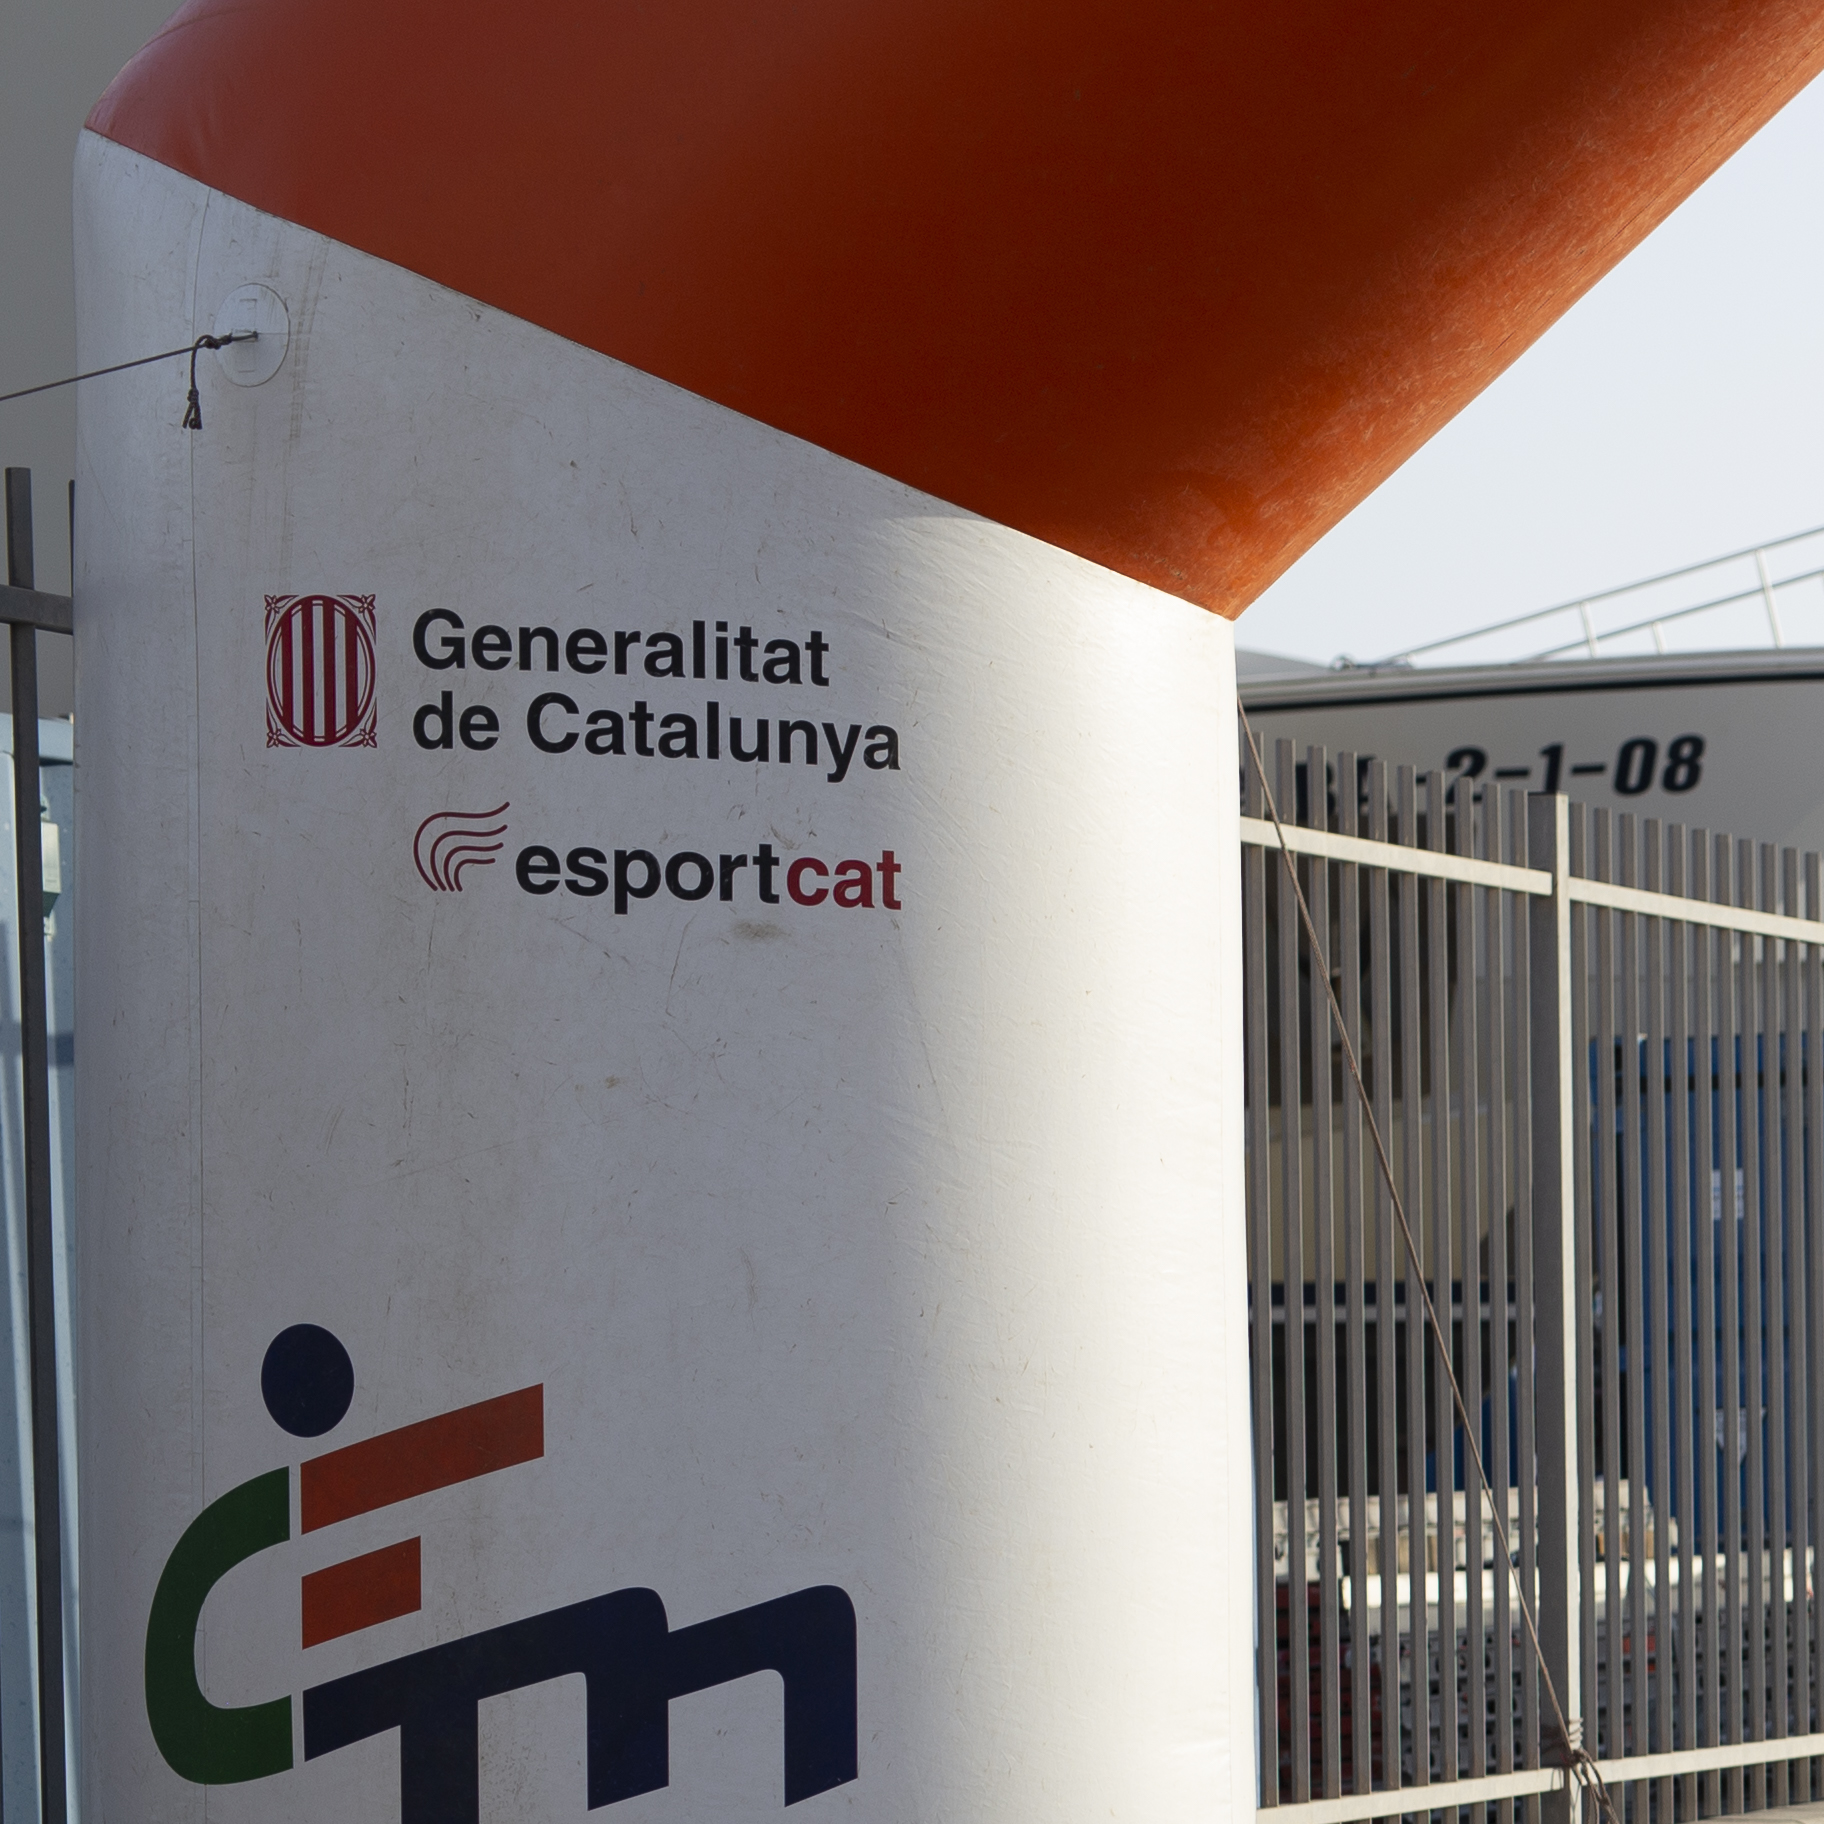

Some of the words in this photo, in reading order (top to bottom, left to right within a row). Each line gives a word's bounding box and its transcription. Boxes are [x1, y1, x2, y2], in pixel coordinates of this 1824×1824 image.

[412, 608, 830, 687] Generalitat
[412, 690, 500, 751] de
[526, 691, 901, 783] Catalunya
[515, 843, 902, 916] esportcat
